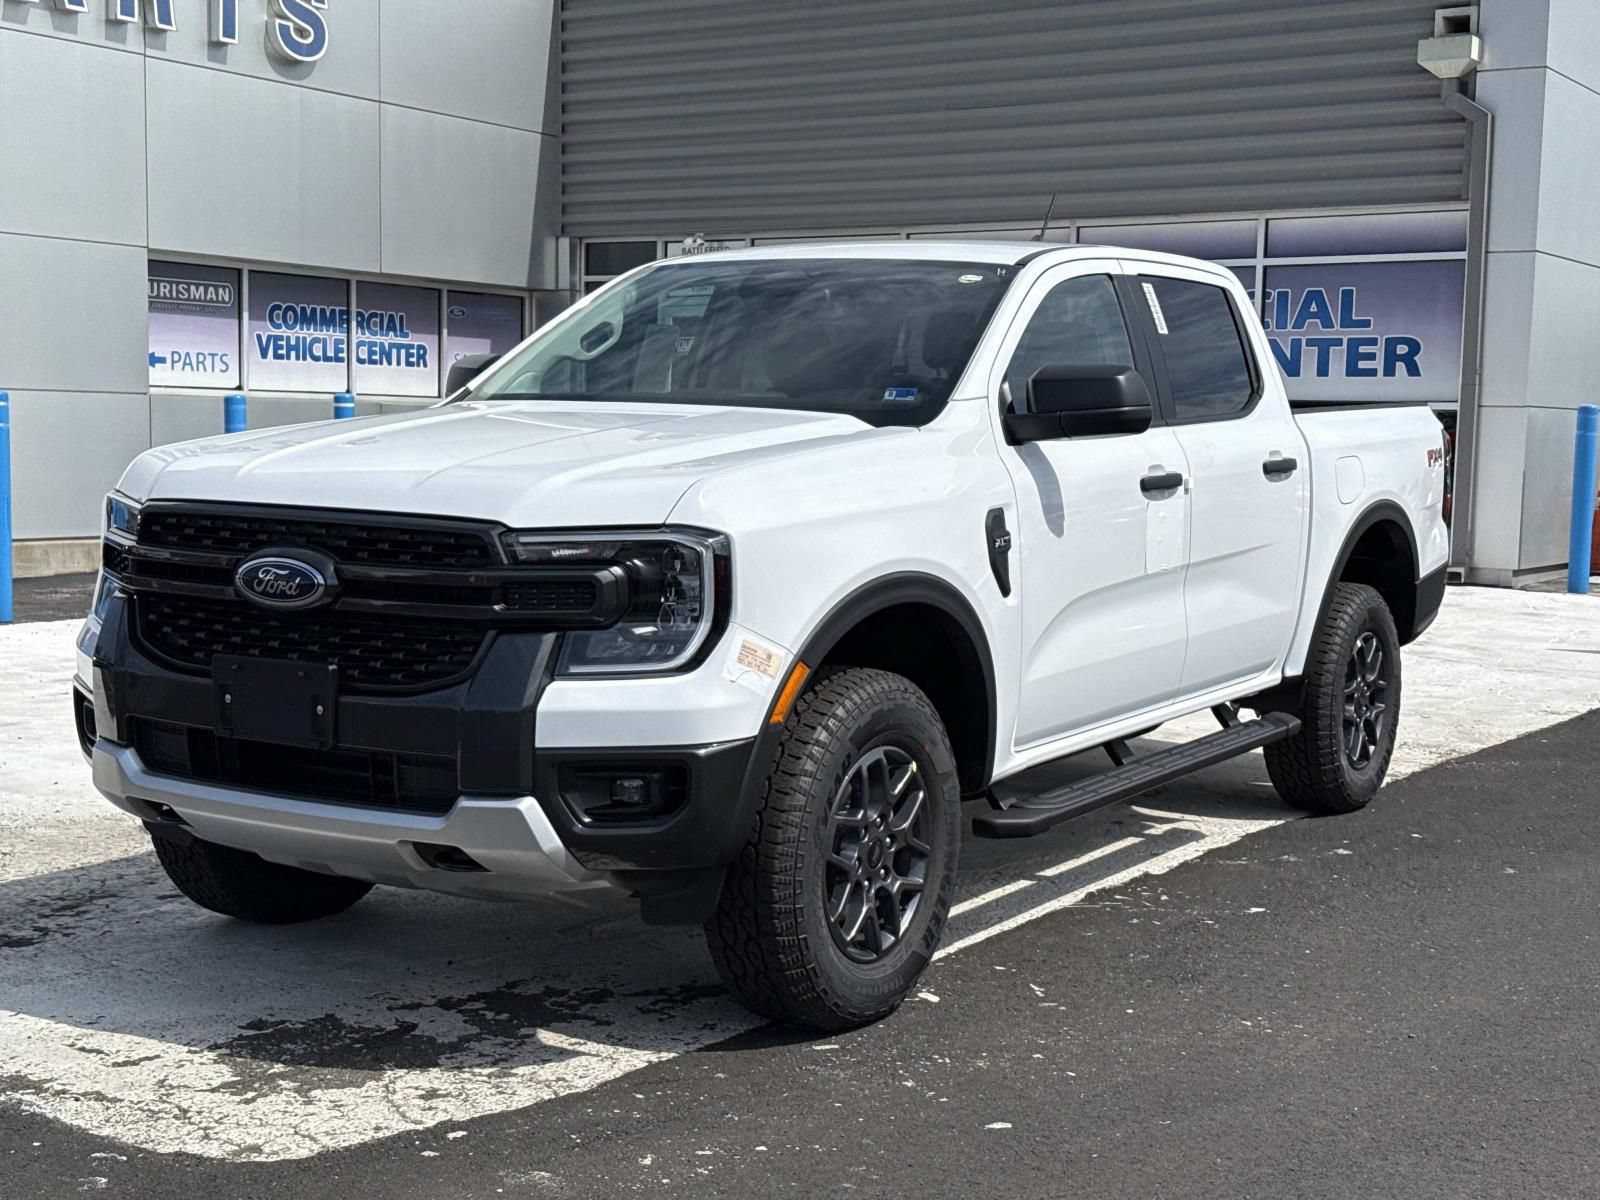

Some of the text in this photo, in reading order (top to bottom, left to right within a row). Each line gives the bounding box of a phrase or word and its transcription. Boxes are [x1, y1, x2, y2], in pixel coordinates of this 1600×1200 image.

[148, 281, 230, 302] URISMAN
[267, 303, 410, 339] COMMERCIAL
[171, 351, 230, 373] PARTS
[255, 333, 428, 368] VEHICLE CENTER
[253, 566, 301, 595] Ford
